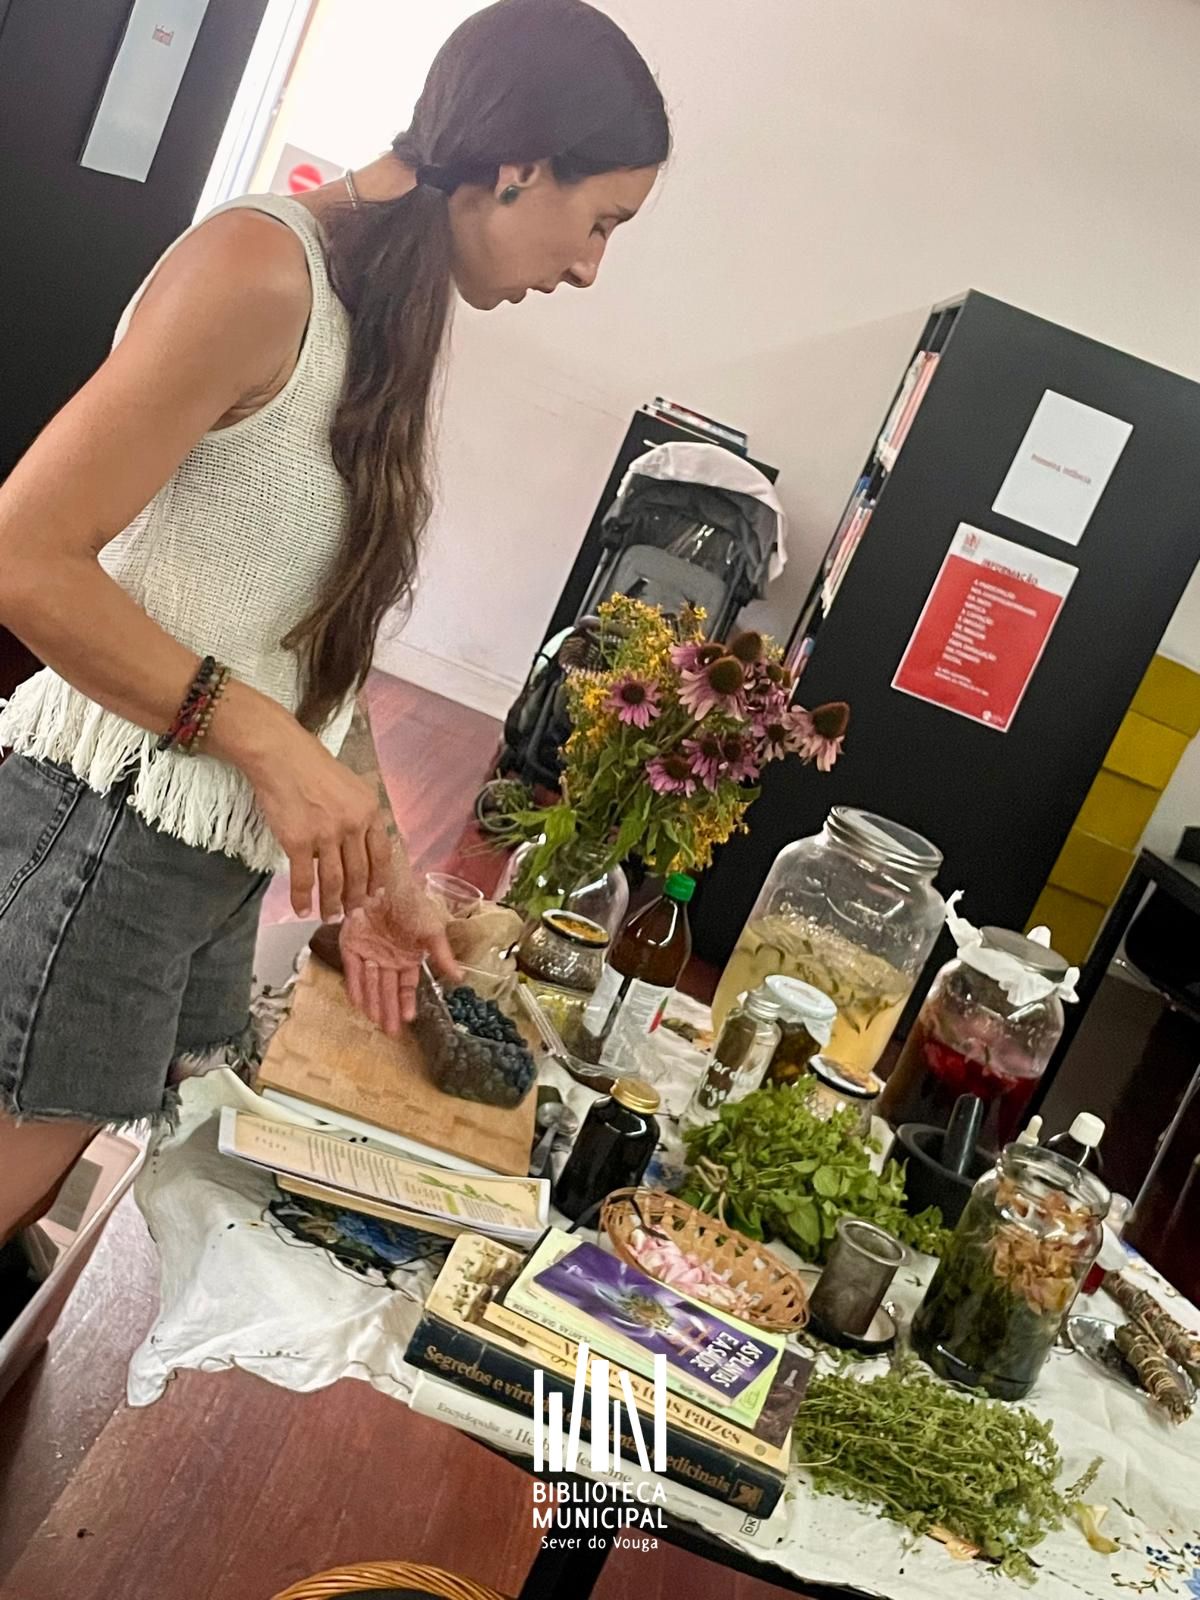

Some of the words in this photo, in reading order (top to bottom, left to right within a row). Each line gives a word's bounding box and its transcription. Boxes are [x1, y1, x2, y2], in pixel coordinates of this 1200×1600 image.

[711, 1336, 733, 1350] A
[718, 1331, 740, 1346] E
[740, 1341, 763, 1360] AS
[710, 1351, 755, 1388] PLANTAS
[424, 1345, 493, 1387] Segredos
[492, 1379, 504, 1391] e
[649, 1450, 731, 1493] edicinais
[685, 1407, 742, 1445] raízes
